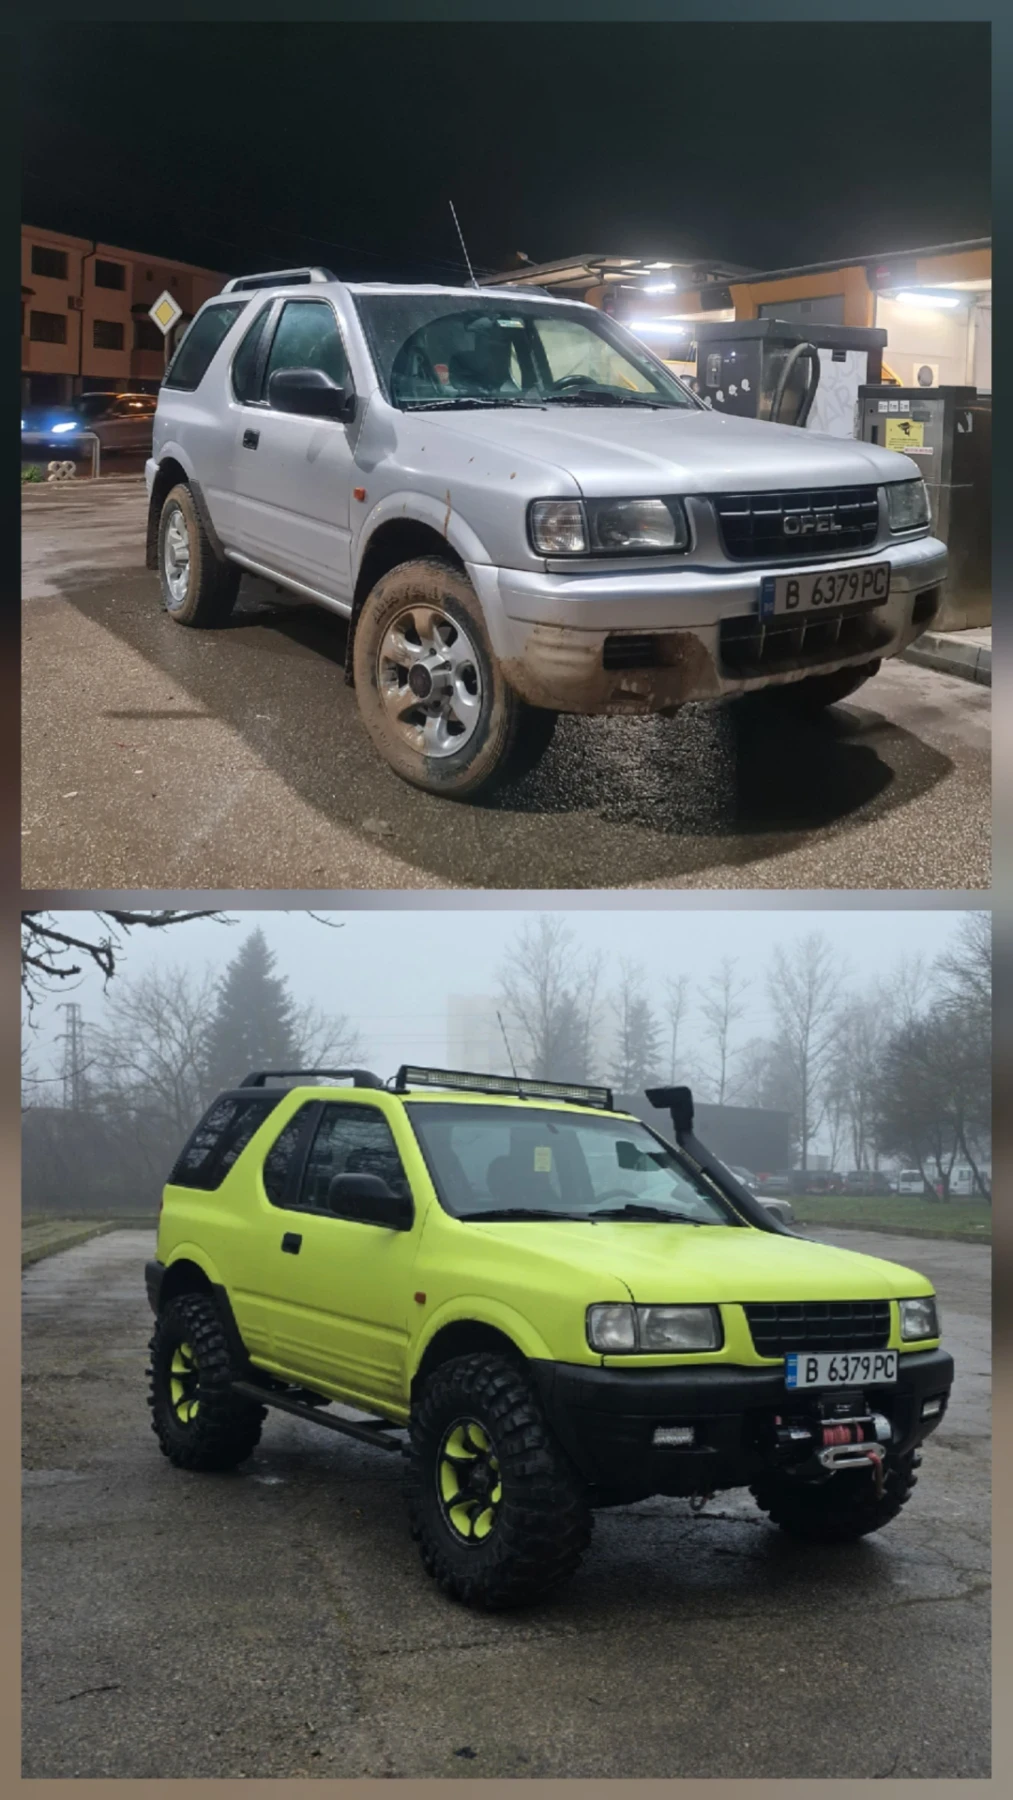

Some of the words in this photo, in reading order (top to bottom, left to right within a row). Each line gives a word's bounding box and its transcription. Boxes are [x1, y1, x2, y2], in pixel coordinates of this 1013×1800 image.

[783, 513, 842, 535] OPEL
[785, 580, 800, 610] B
[806, 1357, 819, 1384] B
